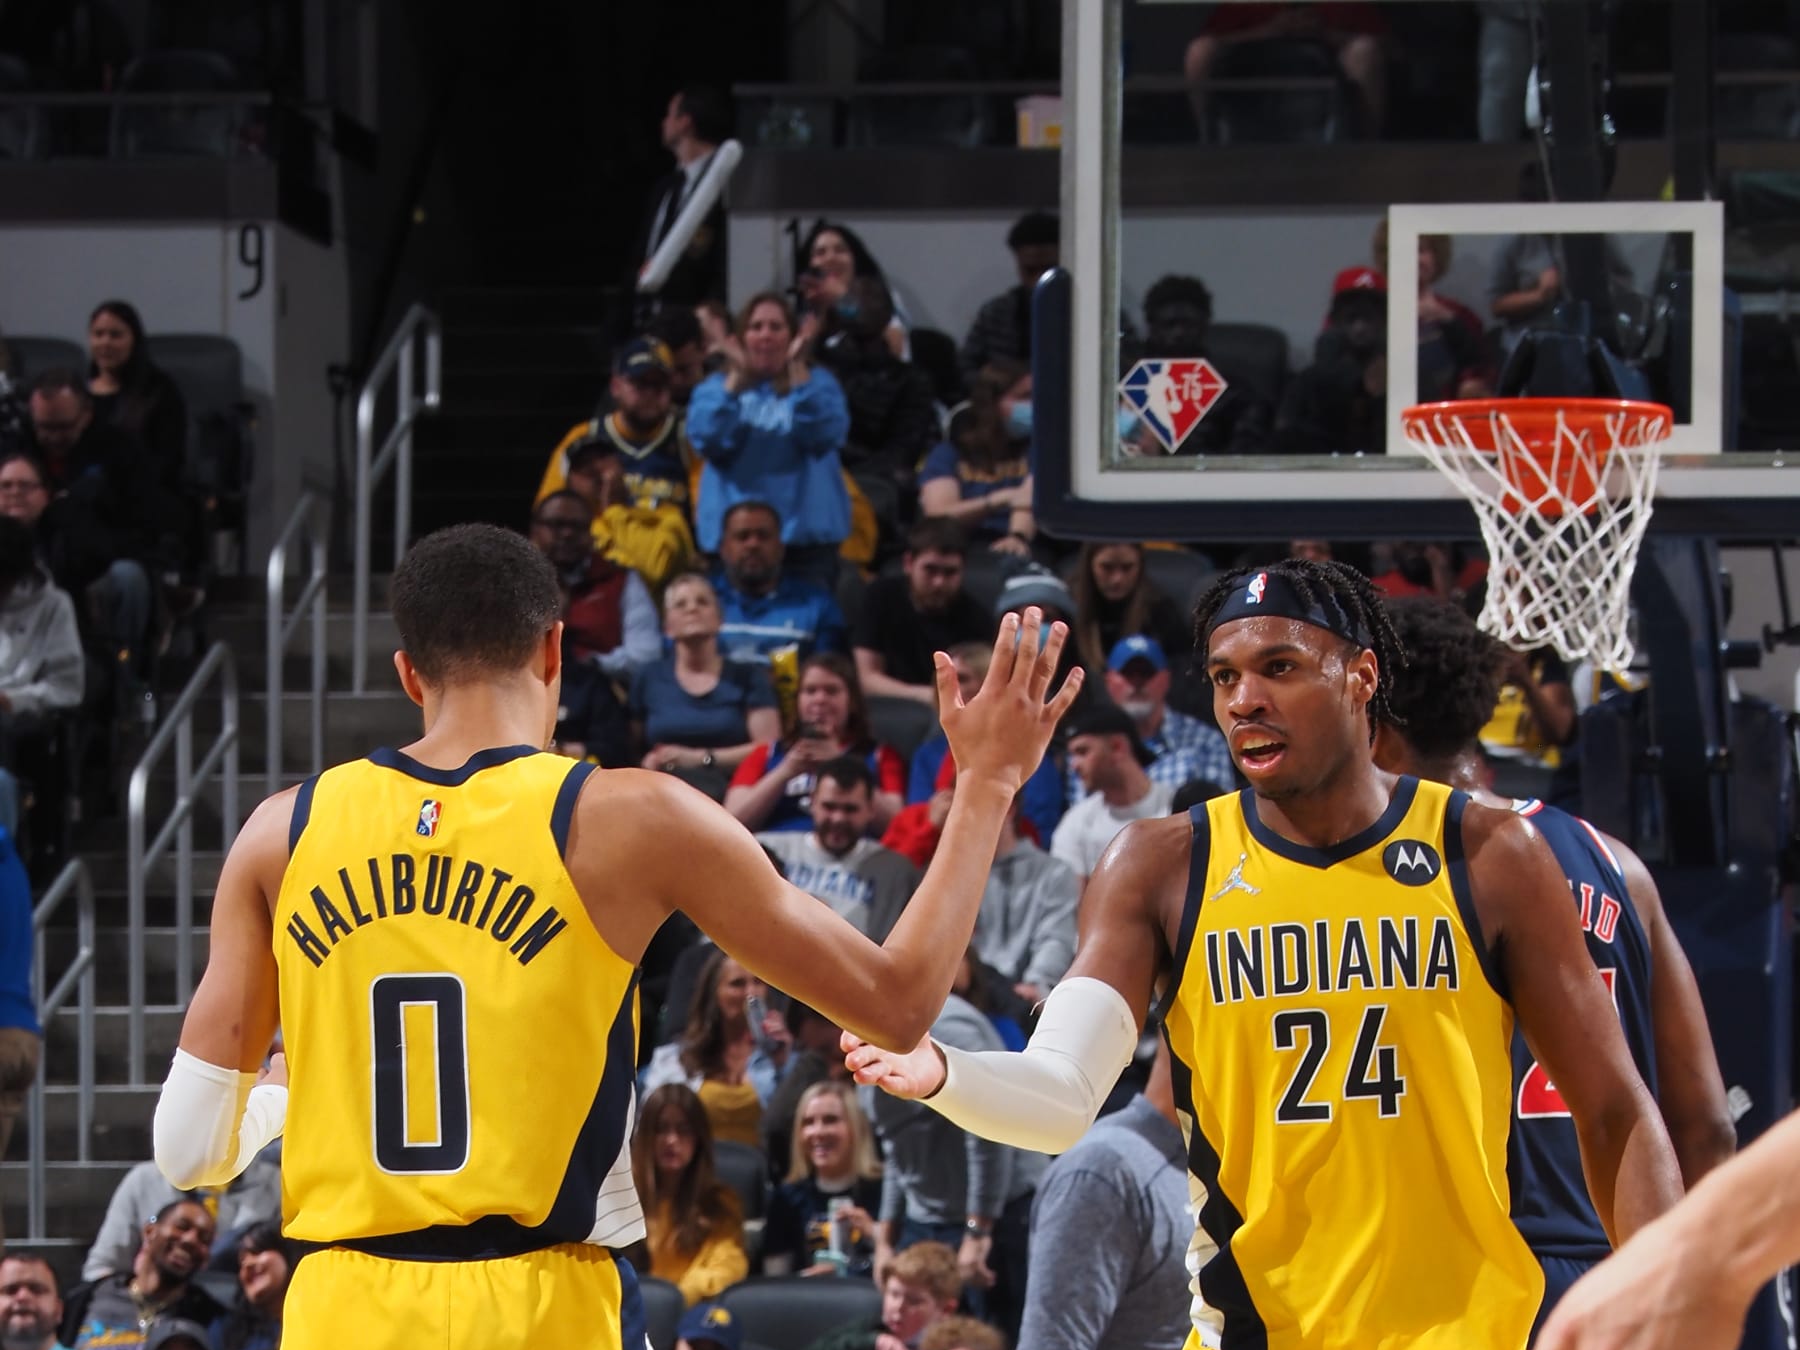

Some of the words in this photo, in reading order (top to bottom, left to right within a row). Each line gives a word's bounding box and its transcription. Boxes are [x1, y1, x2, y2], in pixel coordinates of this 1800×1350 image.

[238, 223, 265, 301] 9
[1181, 372, 1204, 401] 75
[286, 853, 569, 968] HALIBURTON
[1203, 915, 1460, 1007] INDIANA
[370, 974, 470, 1175] 0
[1272, 1003, 1407, 1125] 24
